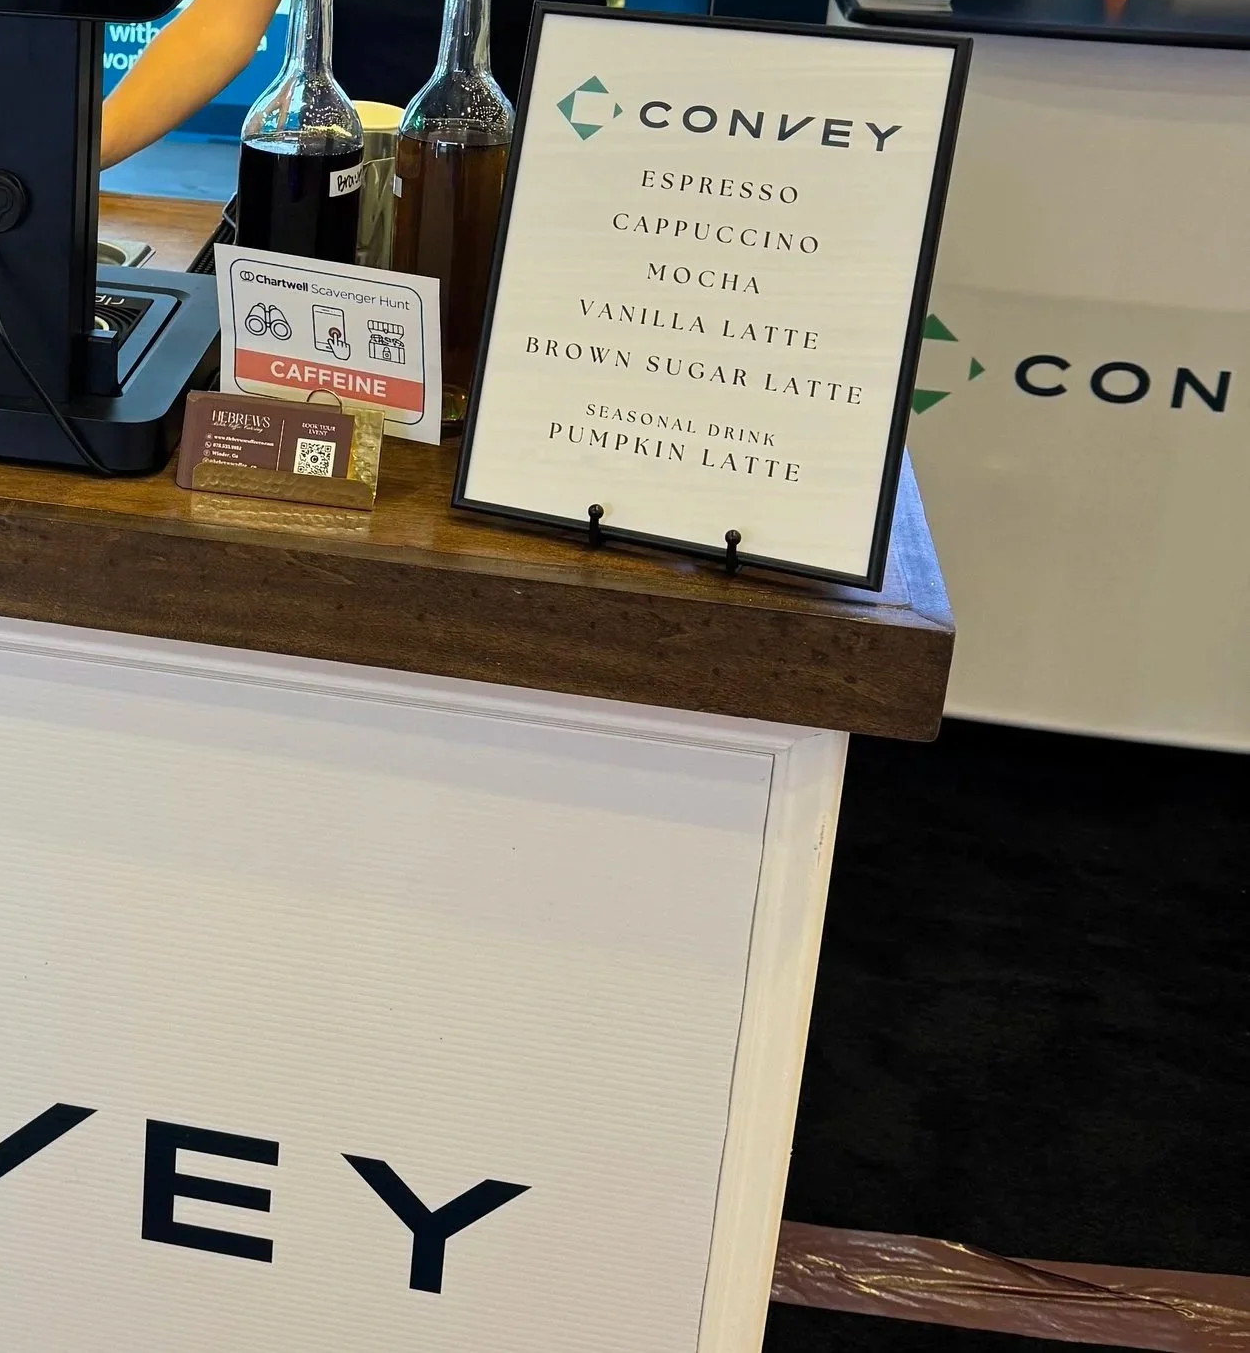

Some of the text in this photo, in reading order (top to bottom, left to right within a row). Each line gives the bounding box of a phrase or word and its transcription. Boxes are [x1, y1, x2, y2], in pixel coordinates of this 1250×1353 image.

[639, 101, 903, 151] CONVEY
[641, 169, 799, 205] ESPRESSO
[613, 212, 819, 254] CAPPUCCINO
[256, 274, 410, 311] Chartwell Scavenger Hunt
[647, 263, 761, 294] MOCHA
[580, 299, 820, 351] VANILLA LATTE
[270, 360, 387, 398] CAFFEINE
[526, 336, 863, 405] BROWN SUGAR LATTE
[212, 409, 271, 429] HEBREWS
[586, 404, 775, 447] SEASONAL DRINK
[549, 422, 801, 482] PUMPKIN LATTE
